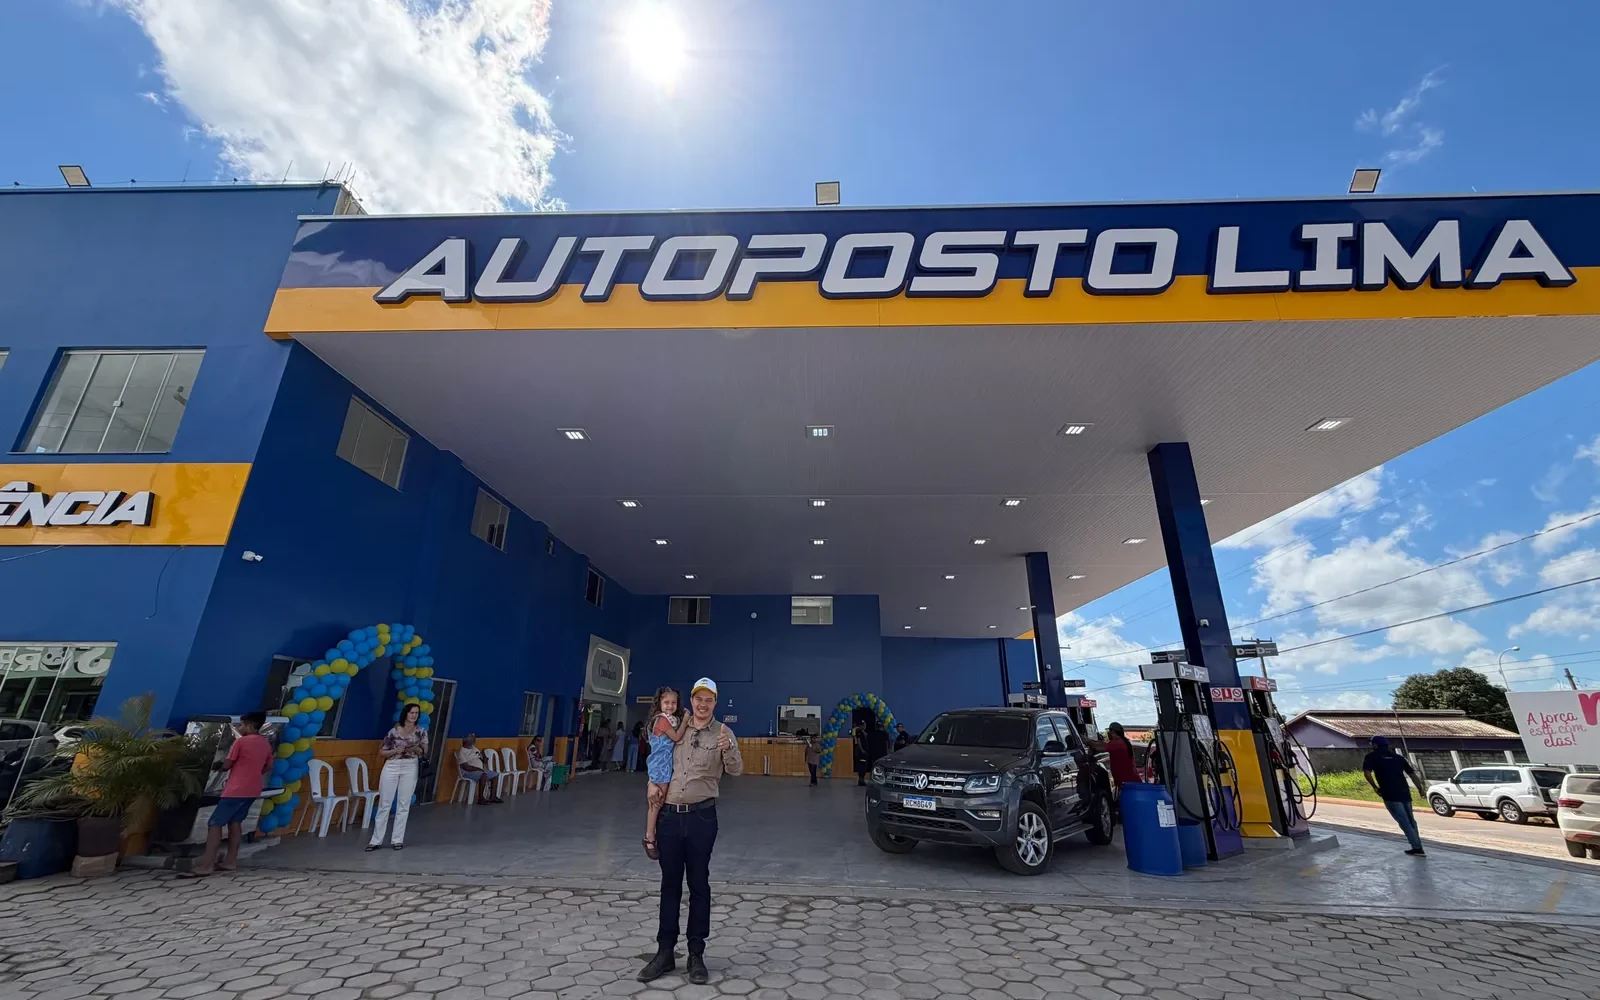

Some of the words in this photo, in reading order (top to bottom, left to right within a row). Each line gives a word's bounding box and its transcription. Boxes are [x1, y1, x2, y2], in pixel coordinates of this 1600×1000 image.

[375, 228, 1179, 303] AUTOPOSTO
[1208, 219, 1577, 294] LIMA
[1527, 712, 1538, 726] A
[1540, 712, 1578, 729] força
[1558, 724, 1588, 734] com
[1544, 732, 1578, 748] elas!
